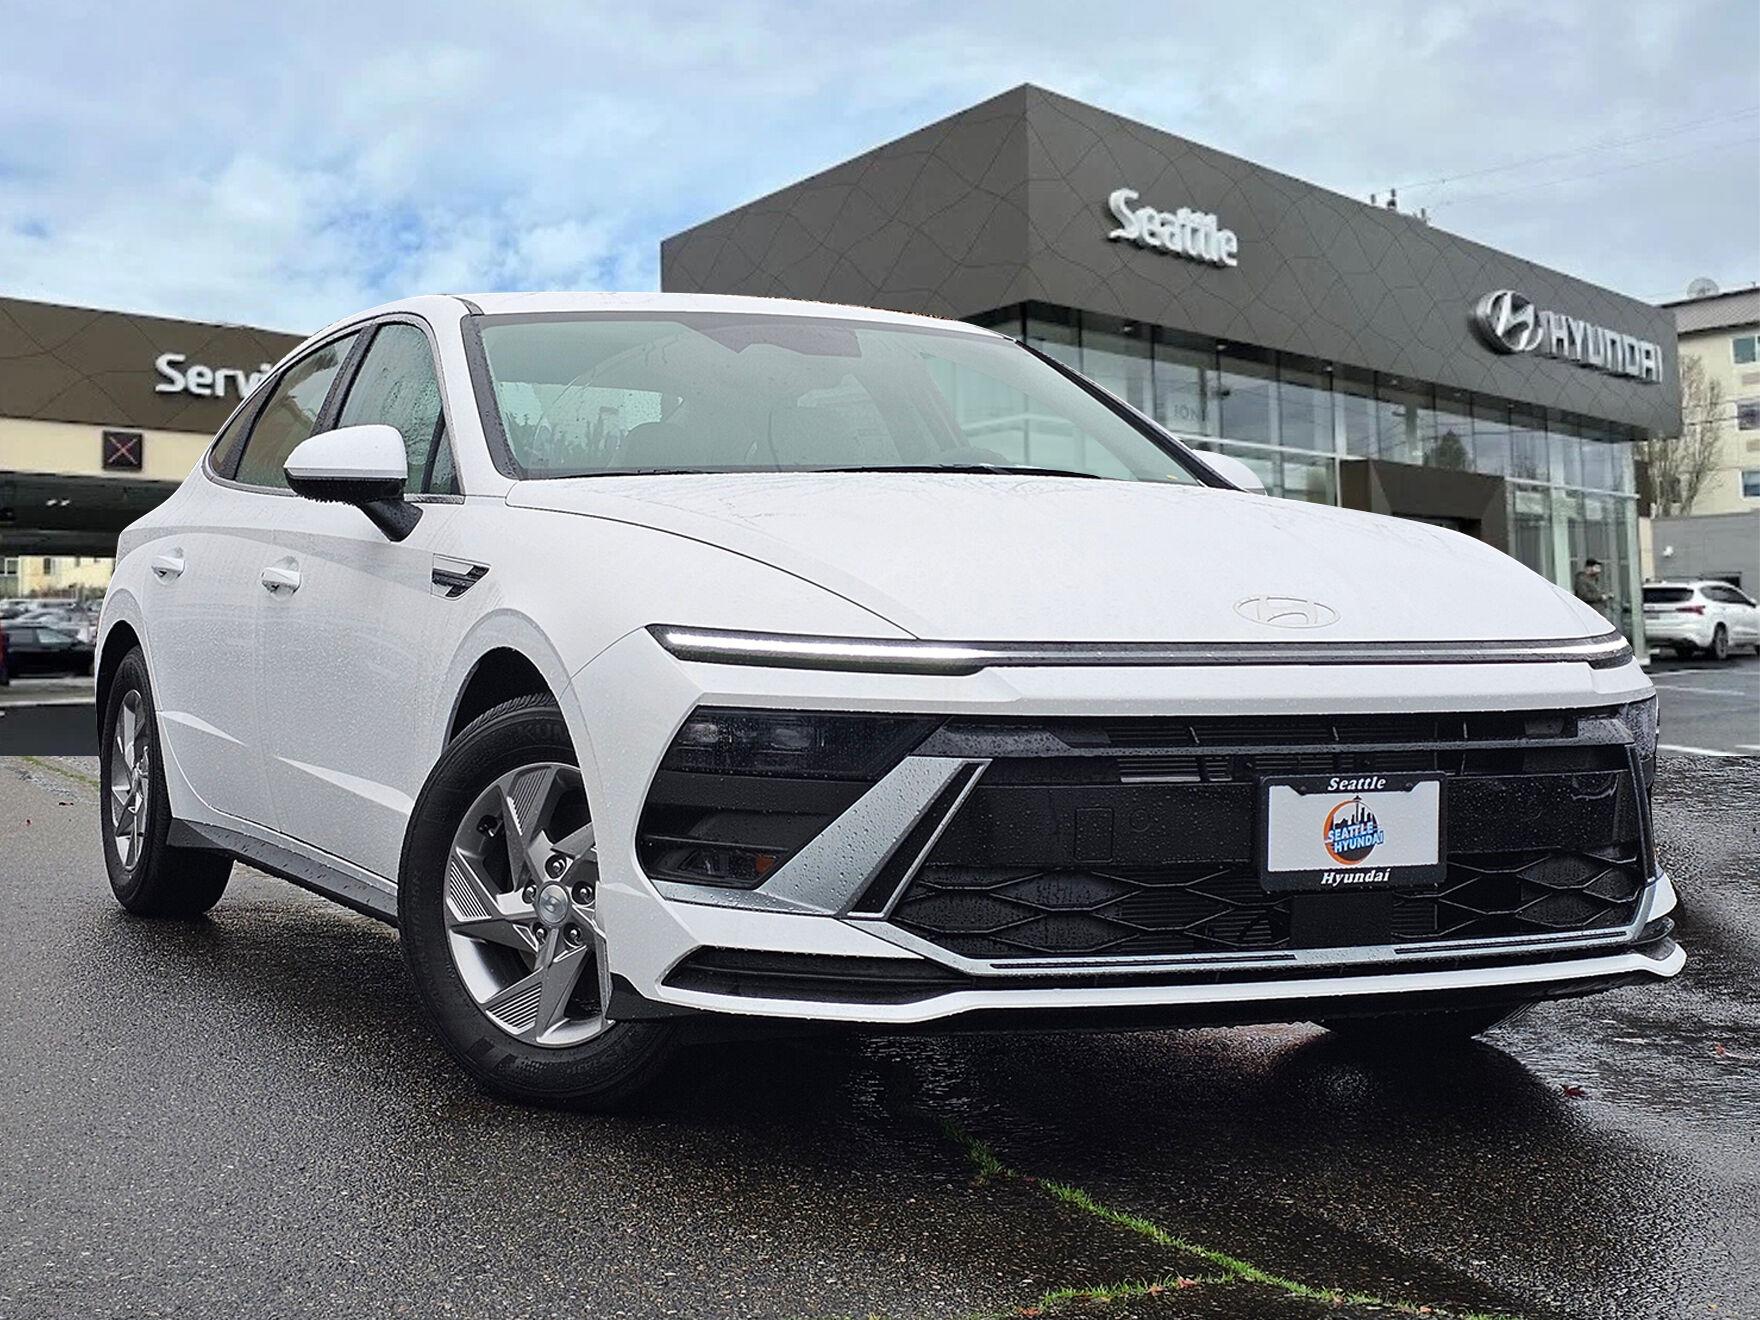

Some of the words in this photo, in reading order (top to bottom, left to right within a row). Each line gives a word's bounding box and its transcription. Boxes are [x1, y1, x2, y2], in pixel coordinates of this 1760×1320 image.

[1109, 187, 1238, 267] Seattle
[1539, 311, 1663, 382] HYUNDAI
[1327, 776, 1387, 791] Seattle
[1327, 822, 1375, 842] SEATTLE
[1333, 830, 1385, 853] HYUNDAI
[1321, 868, 1391, 887] Hyundai
